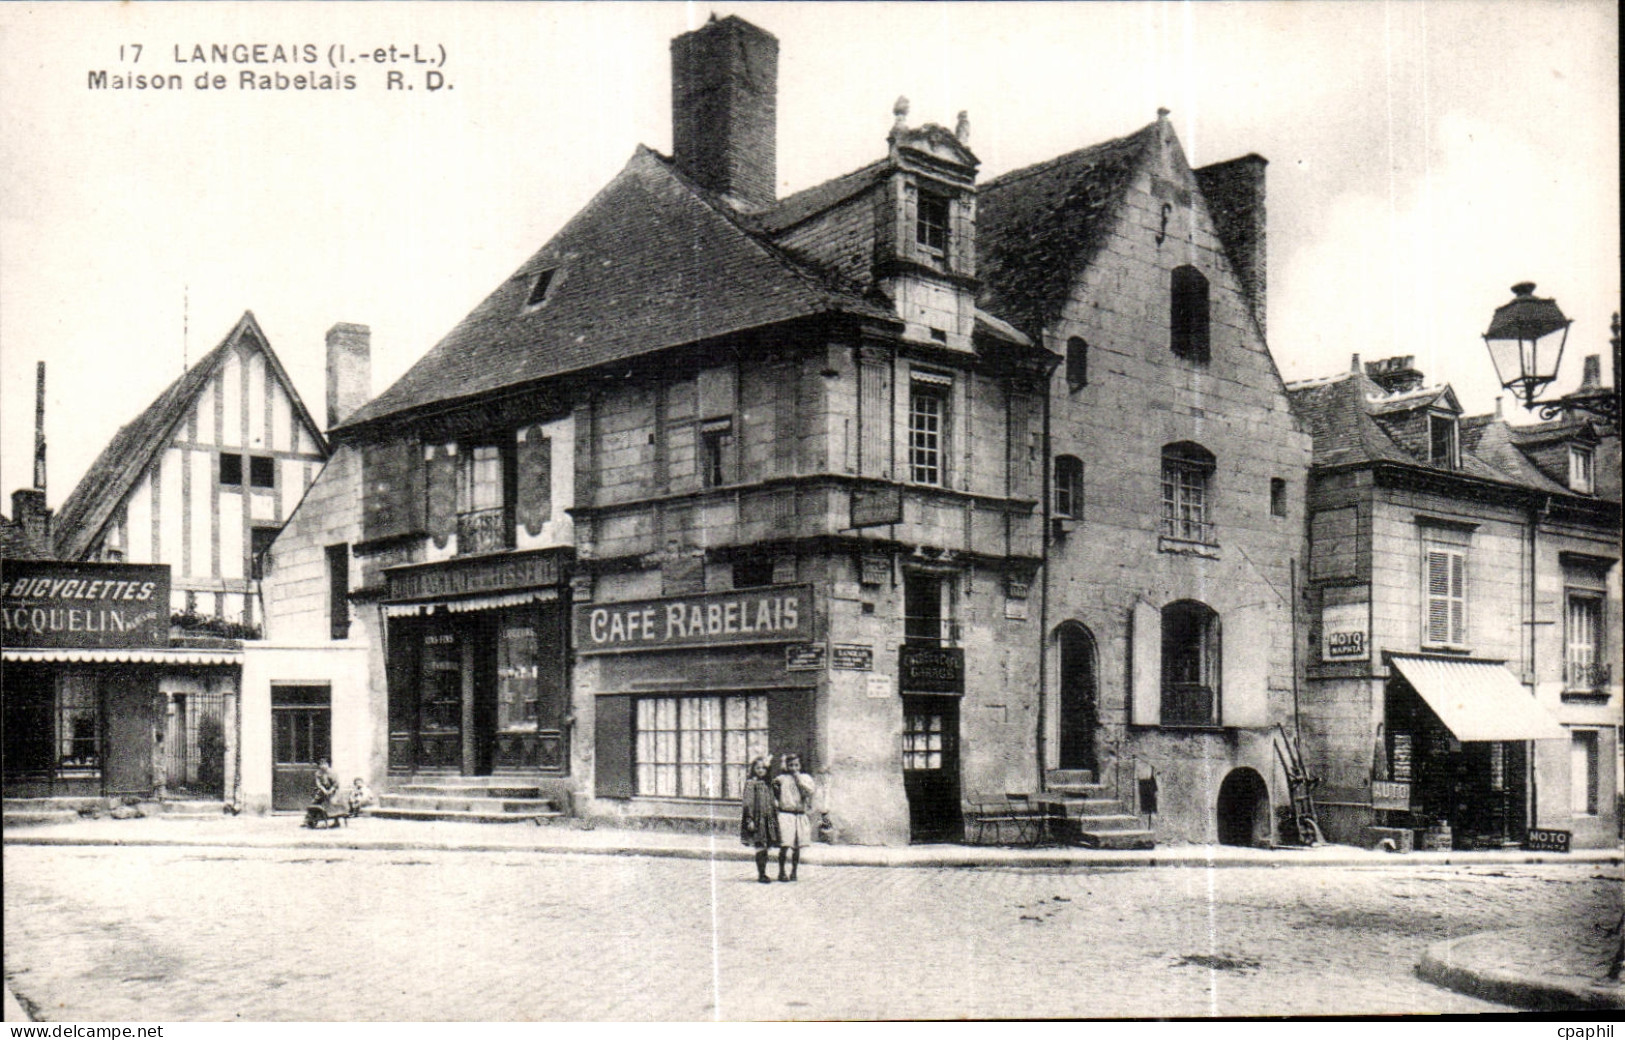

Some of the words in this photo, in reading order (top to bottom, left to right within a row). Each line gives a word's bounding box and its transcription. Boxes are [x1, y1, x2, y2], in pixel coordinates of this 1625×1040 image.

[589, 605, 655, 644] CAFÉ
[664, 597, 799, 642] RABELAIS
[1330, 632, 1362, 645] MOTO
[1374, 783, 1410, 799] AUTO
[1529, 831, 1567, 843] MOTO
